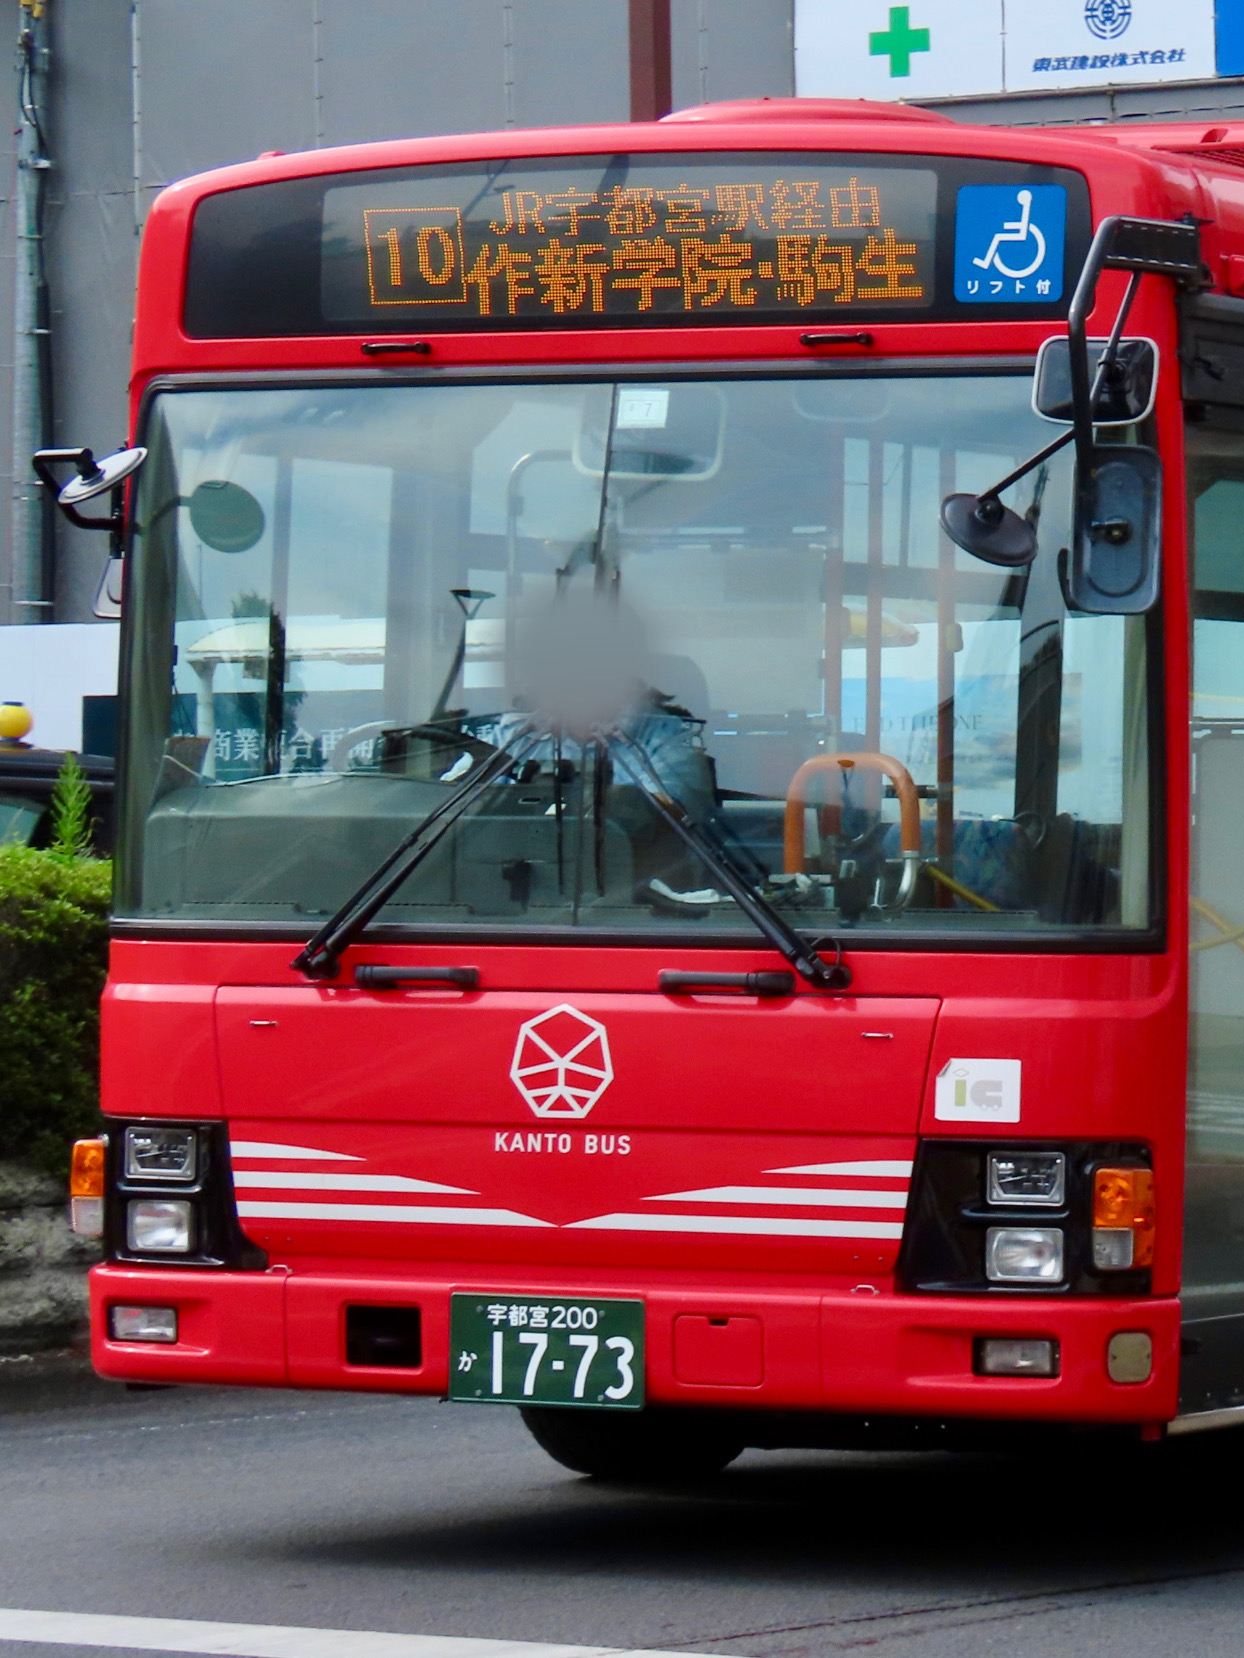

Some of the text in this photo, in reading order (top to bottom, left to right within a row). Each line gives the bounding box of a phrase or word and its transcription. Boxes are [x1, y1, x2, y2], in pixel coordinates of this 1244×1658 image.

[1032, 48, 1186, 73] 東武建設株式会社
[489, 176, 881, 236] JR宇都宮駅経由
[377, 226, 456, 287] 10
[967, 279, 1051, 295] リフト付
[494, 1132, 632, 1155] KANTO BUS
[458, 1330, 635, 1400] か 17-73
